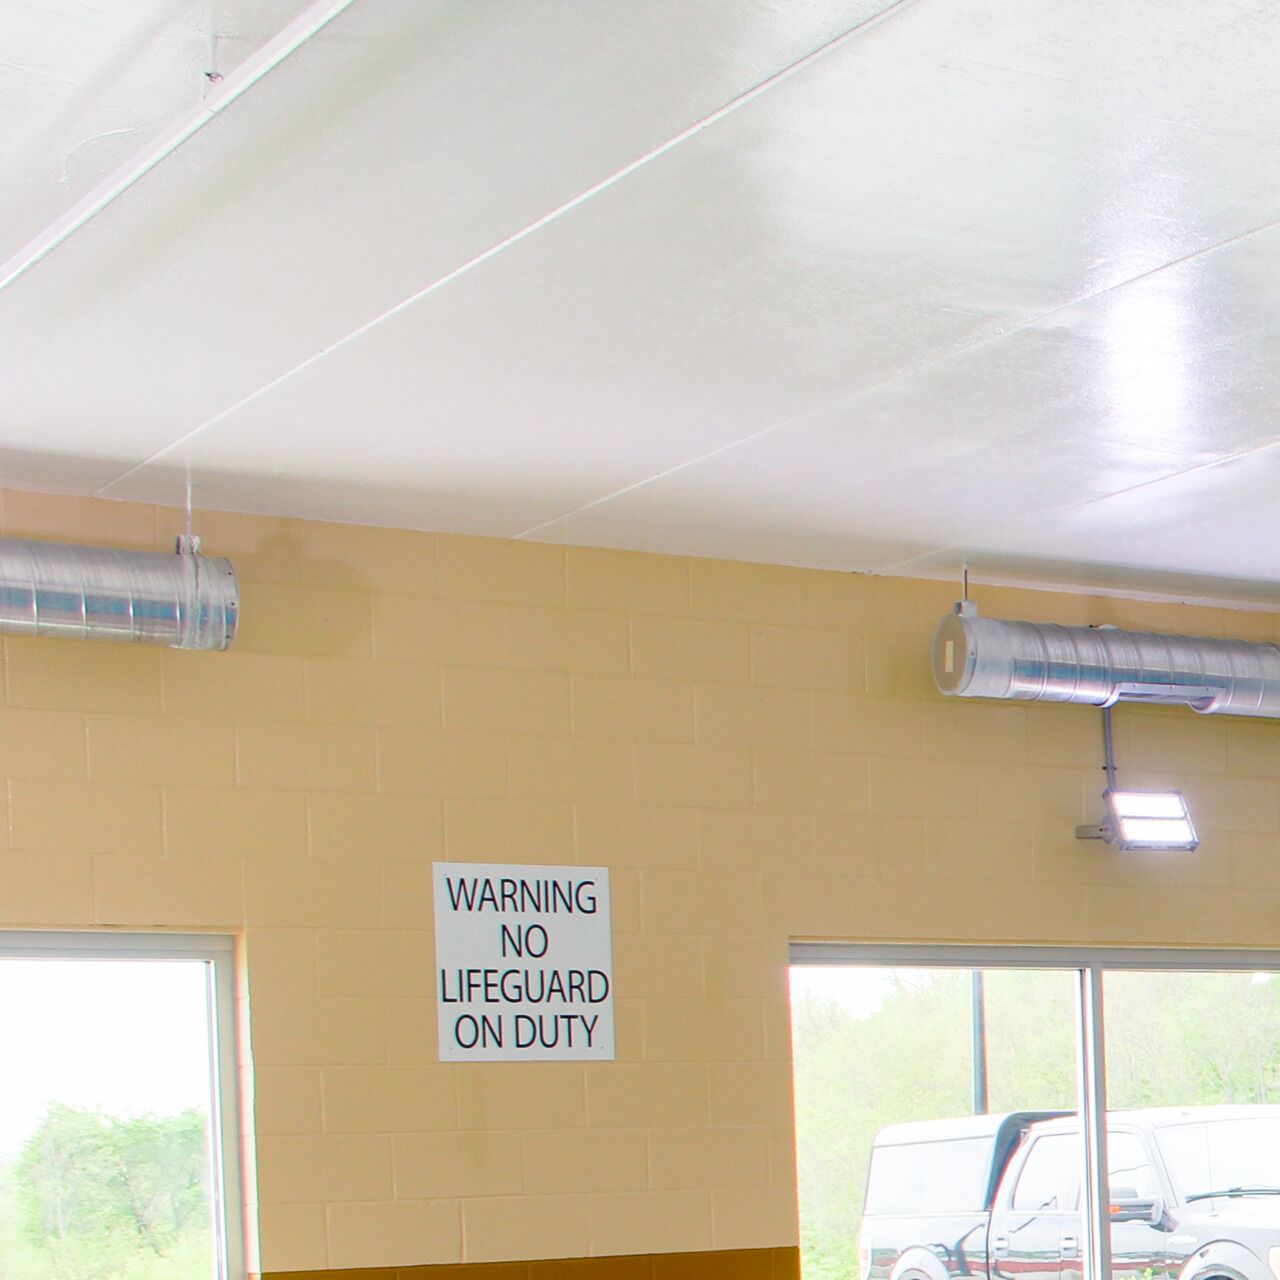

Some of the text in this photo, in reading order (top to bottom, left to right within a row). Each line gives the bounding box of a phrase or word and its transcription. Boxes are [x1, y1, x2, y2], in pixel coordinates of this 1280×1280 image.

[445, 876, 598, 914] WARNING
[500, 924, 549, 959] NO
[440, 968, 610, 1004] LIFEGUARD
[454, 1014, 599, 1049] ON DUTY
